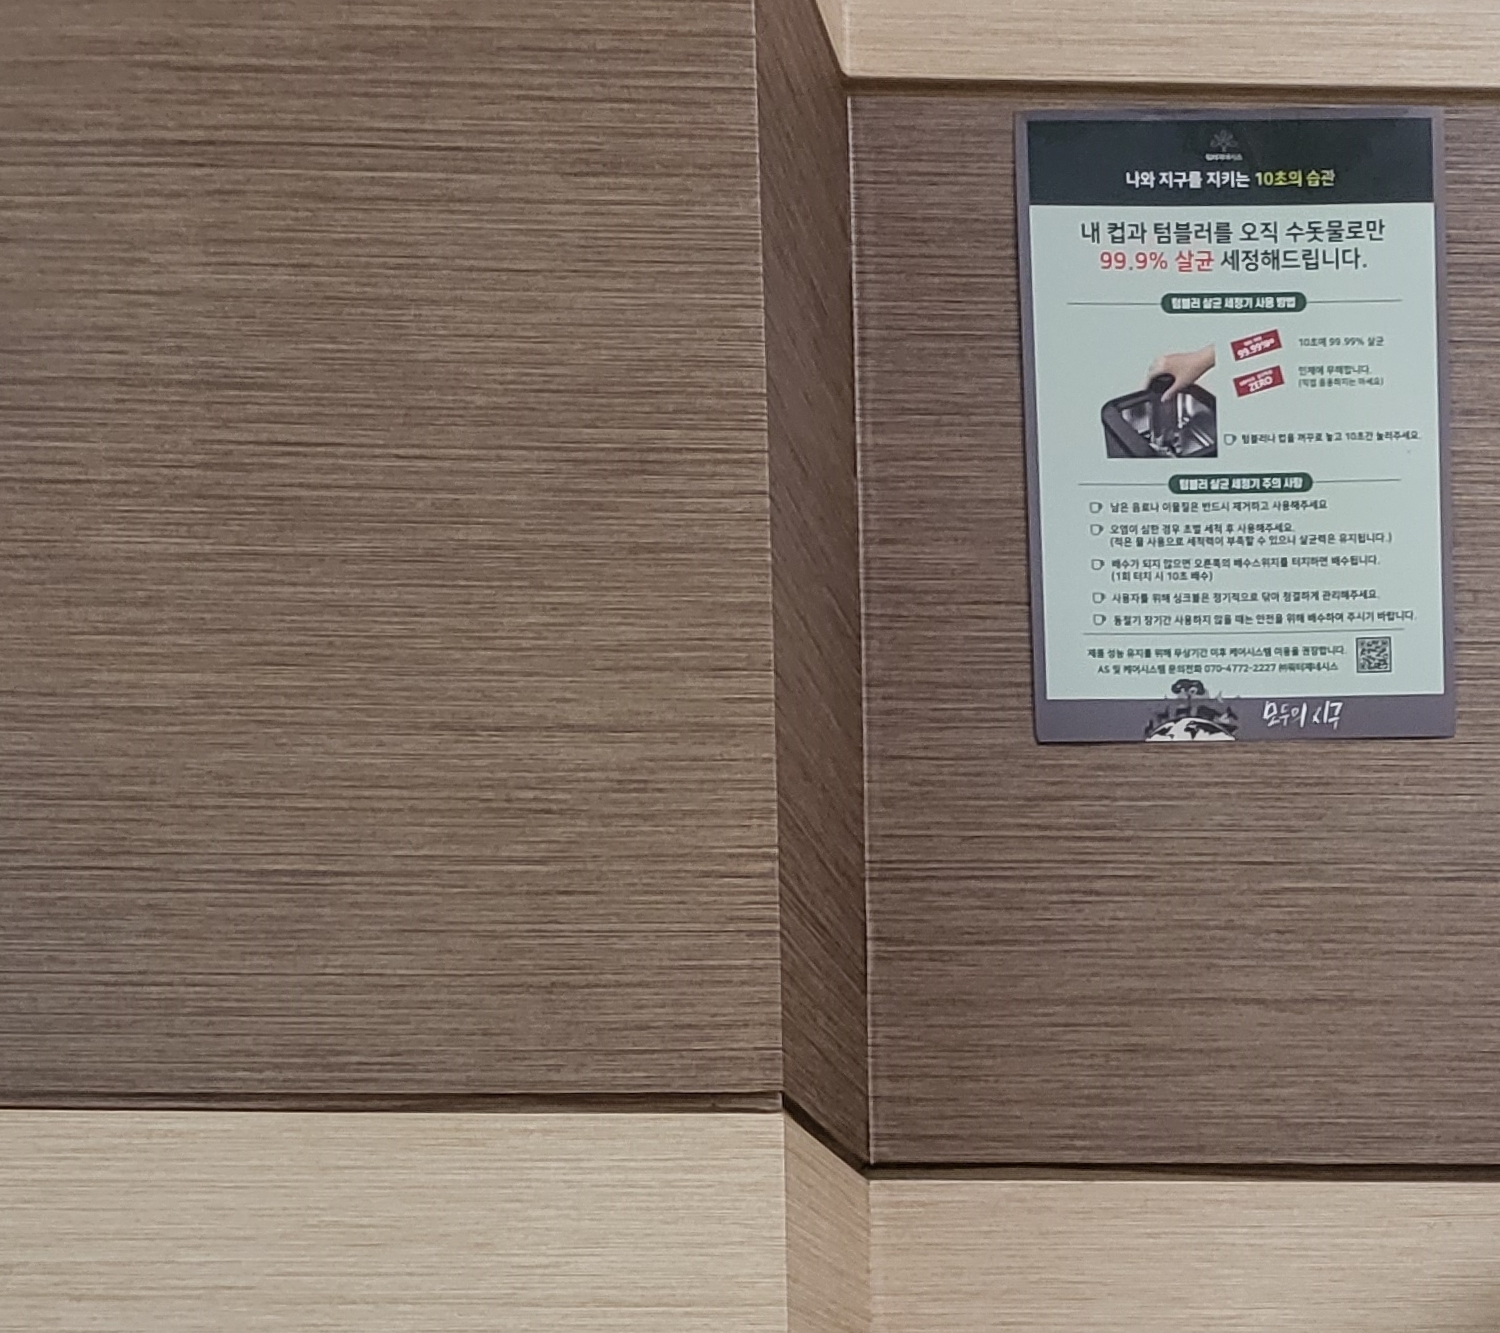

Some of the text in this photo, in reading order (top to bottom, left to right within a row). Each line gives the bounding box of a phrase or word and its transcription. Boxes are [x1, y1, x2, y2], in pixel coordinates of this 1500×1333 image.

[1126, 169, 1335, 189] 나와 지구를 지키는 10초의 습관
[1081, 219, 1386, 244] 내 컵과 텀블러를 오직 수돗물로만
[1100, 248, 1369, 273] 99.9% 살균 세정해드립니다.
[1171, 297, 1201, 310] 텀블러
[1202, 297, 1223, 310] 살균
[1255, 297, 1274, 309] 사용
[1276, 296, 1297, 308] 방법
[1367, 336, 1384, 347] 살균
[1345, 431, 1373, 441] 10초간
[1179, 478, 1208, 490] 텀블러
[1210, 478, 1229, 490] 살균
[1262, 477, 1281, 489] 주의
[1284, 477, 1303, 489] 사항
[1110, 502, 1129, 513] 남은
[1132, 502, 1159, 513] 음료나
[1202, 501, 1229, 512] 반드시
[1233, 501, 1269, 512] 제거하고
[1141, 524, 1159, 535] 심한
[1162, 524, 1180, 535] 경우
[1204, 524, 1223, 534] 세척
[1226, 524, 1234, 534] 후
[1238, 522, 1295, 534] 사용해주세요.
[1110, 536, 1133, 547] (적은
[1136, 537, 1144, 547] 물
[1147, 536, 1184, 547] 사용으로
[1227, 536, 1255, 546] 부족할
[1257, 536, 1266, 545] 수
[1268, 535, 1296, 545] 있으니
[1300, 534, 1336, 545] 살균력은
[1111, 558, 1139, 569] 배수가
[1142, 558, 1160, 569] 되지
[1163, 558, 1191, 569] 않으면
[1233, 557, 1288, 568] 배수스위치를
[1291, 556, 1328, 567] 터치하면
[1111, 571, 1213, 582] (1회 터치 시 10초 배수)
[1112, 593, 1148, 604] 사용자를
[1152, 593, 1170, 604] 위해
[1213, 592, 1258, 603] 정기적으로
[1282, 591, 1319, 602] 청결하게
[1322, 589, 1380, 601] 관리해주세요.
[1144, 615, 1172, 626] 장기간
[1175, 614, 1211, 626] 사용하지
[1213, 614, 1232, 625] 않을
[1234, 614, 1253, 625] 때는
[1286, 613, 1305, 624] 위해
[1307, 612, 1344, 624] 배수하여
[1347, 611, 1374, 622] 주시기
[1107, 648, 1124, 659] 성능
[1126, 648, 1151, 659] 유지를
[1155, 648, 1171, 658] 위해
[1174, 648, 1208, 658] 무상기간
[1210, 648, 1226, 658] 이후
[1098, 665, 1110, 674] AS
[1113, 665, 1121, 674] 및
[1204, 663, 1276, 674] 070-4772-2227
[1263, 701, 1307, 728] 모두의
